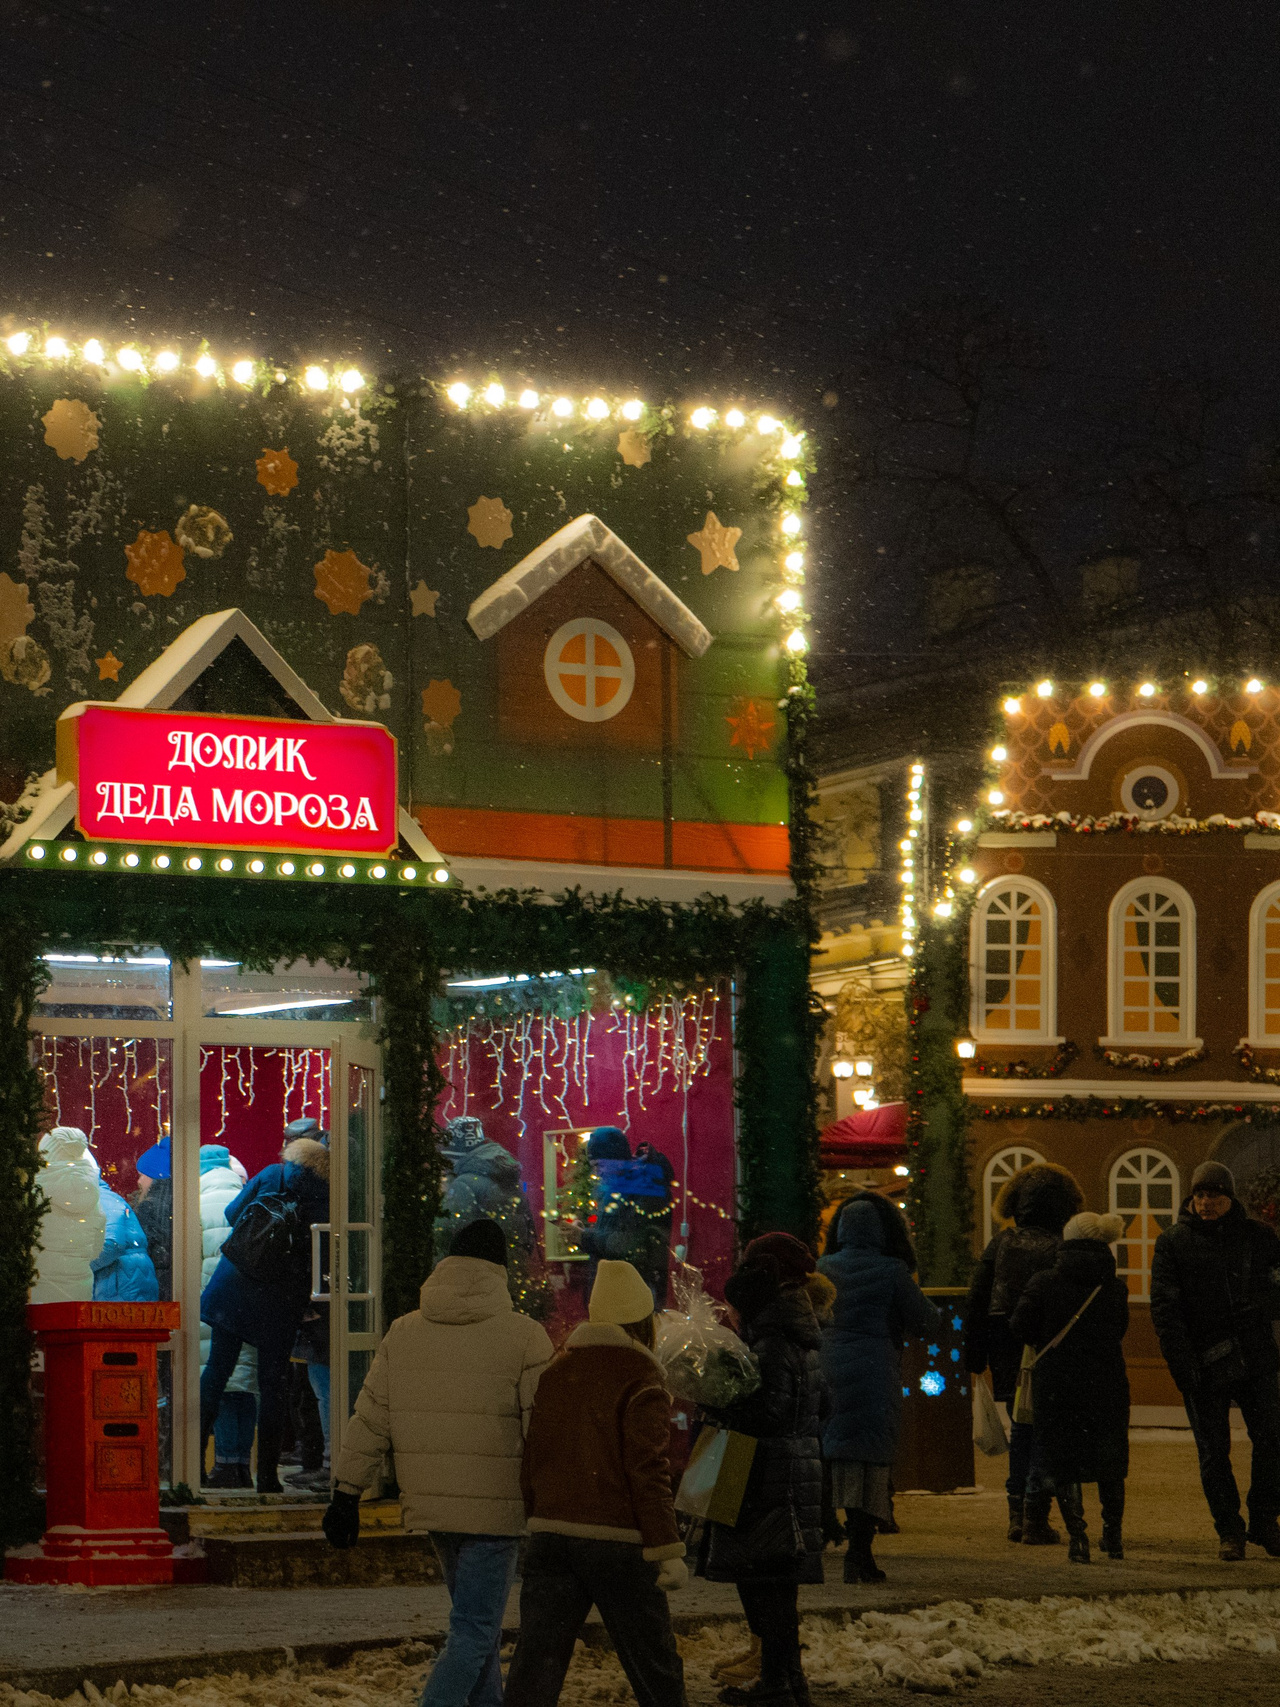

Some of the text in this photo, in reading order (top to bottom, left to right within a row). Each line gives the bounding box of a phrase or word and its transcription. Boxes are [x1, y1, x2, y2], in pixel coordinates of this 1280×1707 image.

[167, 730, 317, 781] ДОМИК
[96, 781, 379, 831] ДЕДА МОРОЗА
[89, 1306, 165, 1323] ПОЧТА
